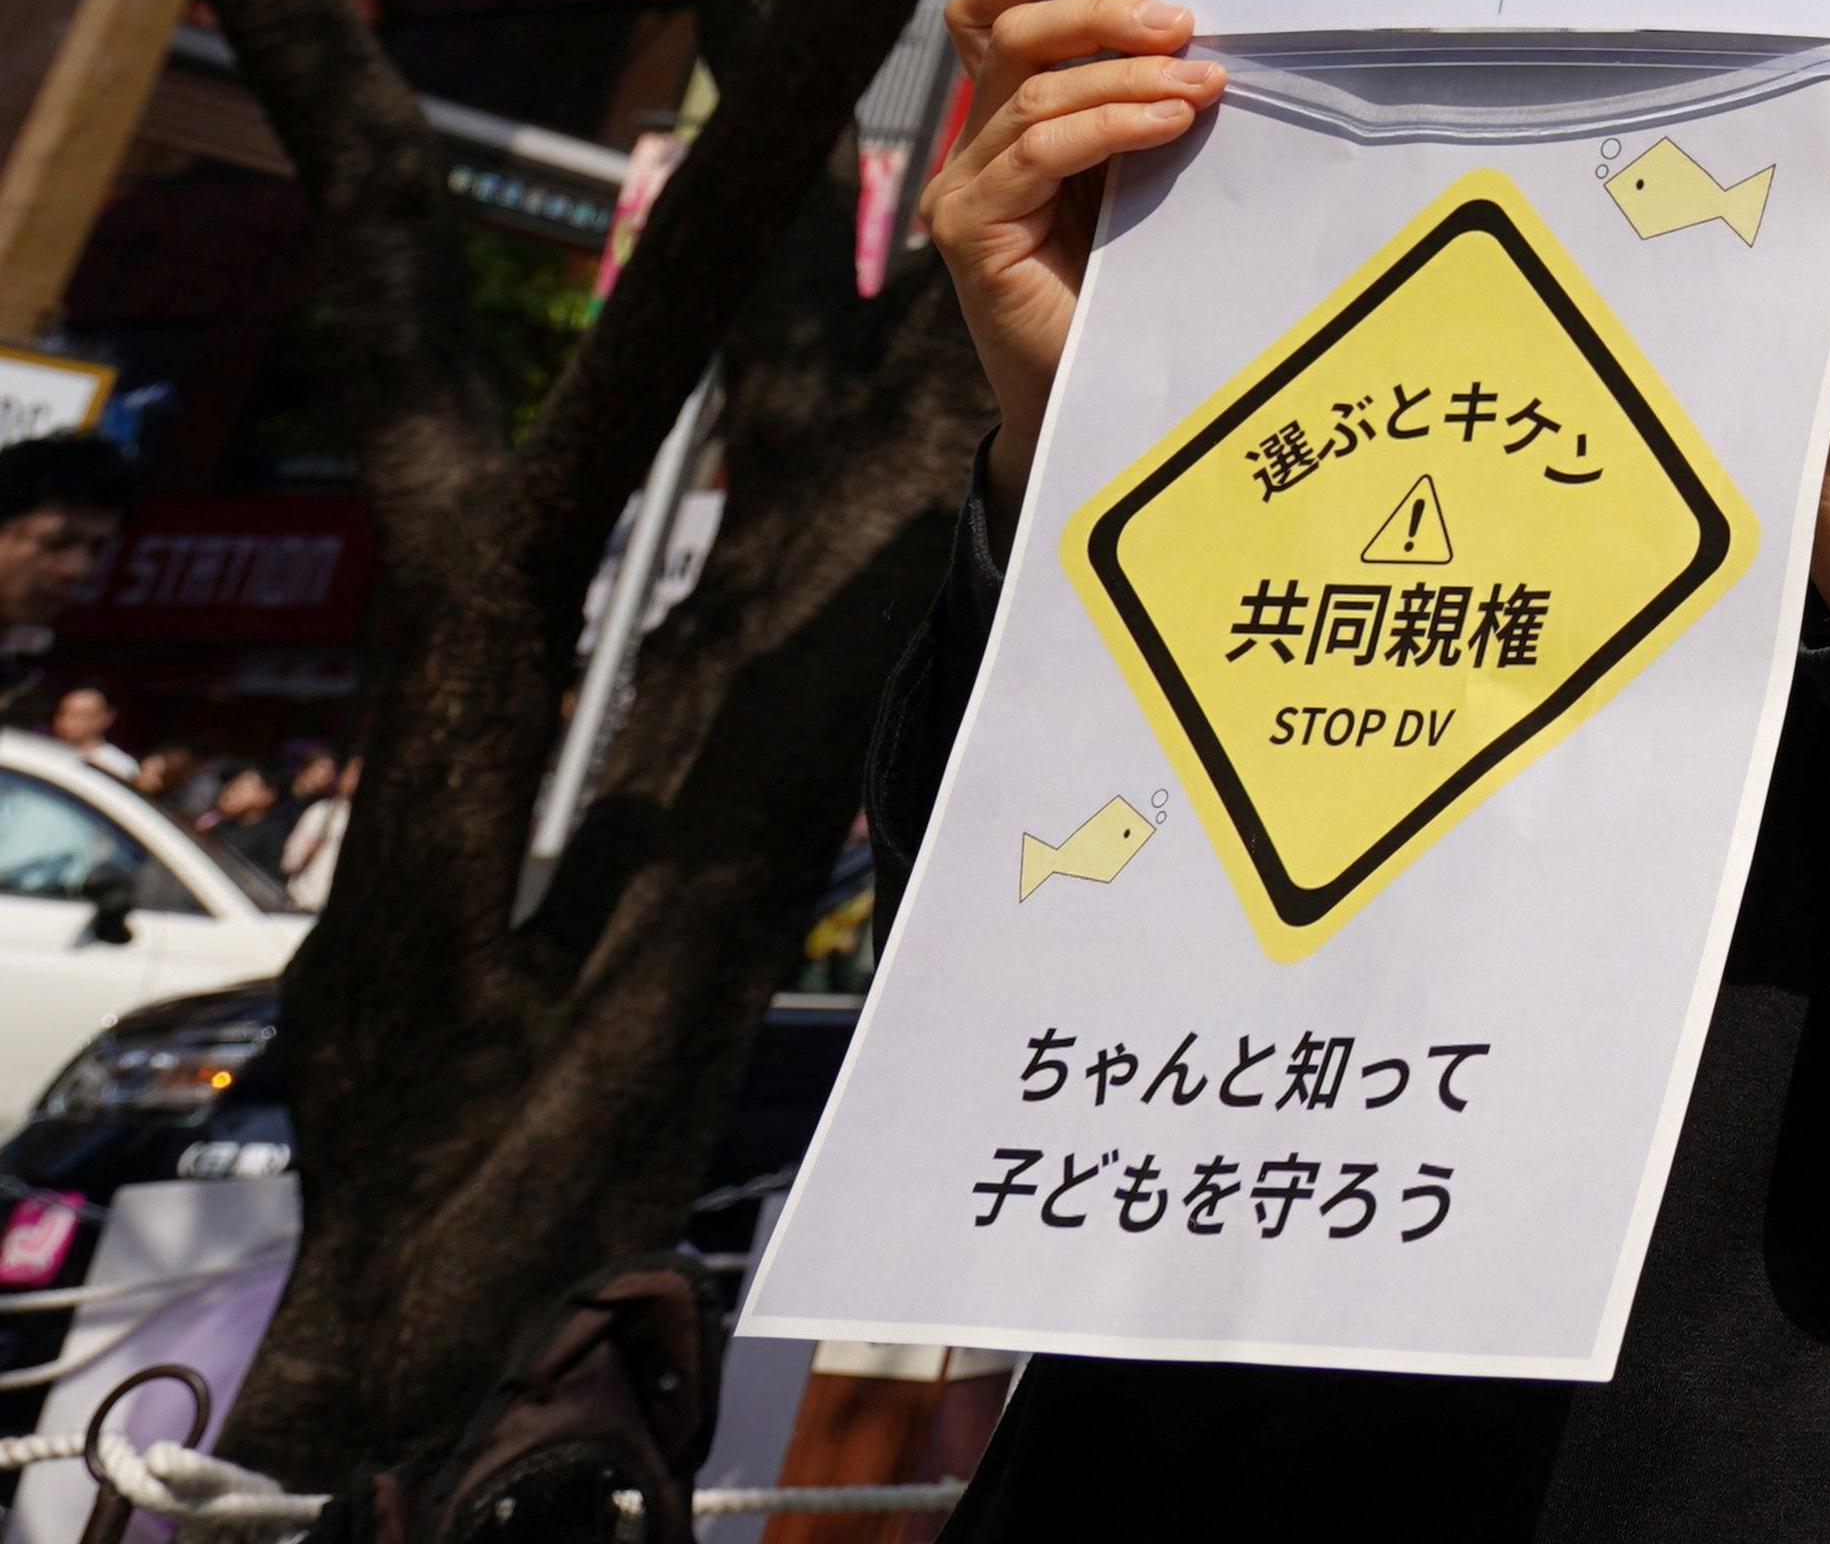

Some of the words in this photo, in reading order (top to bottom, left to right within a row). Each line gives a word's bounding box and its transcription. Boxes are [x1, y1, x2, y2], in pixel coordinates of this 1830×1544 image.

[1245, 381, 1603, 504] 選ぶとキケン
[1225, 579, 1553, 669] 共同親権
[1269, 706, 1387, 747] STOP
[1393, 708, 1456, 748] DV
[1020, 1028, 1491, 1112] ちゃんと知って
[971, 1147, 1455, 1243] 子どもを守ろう
